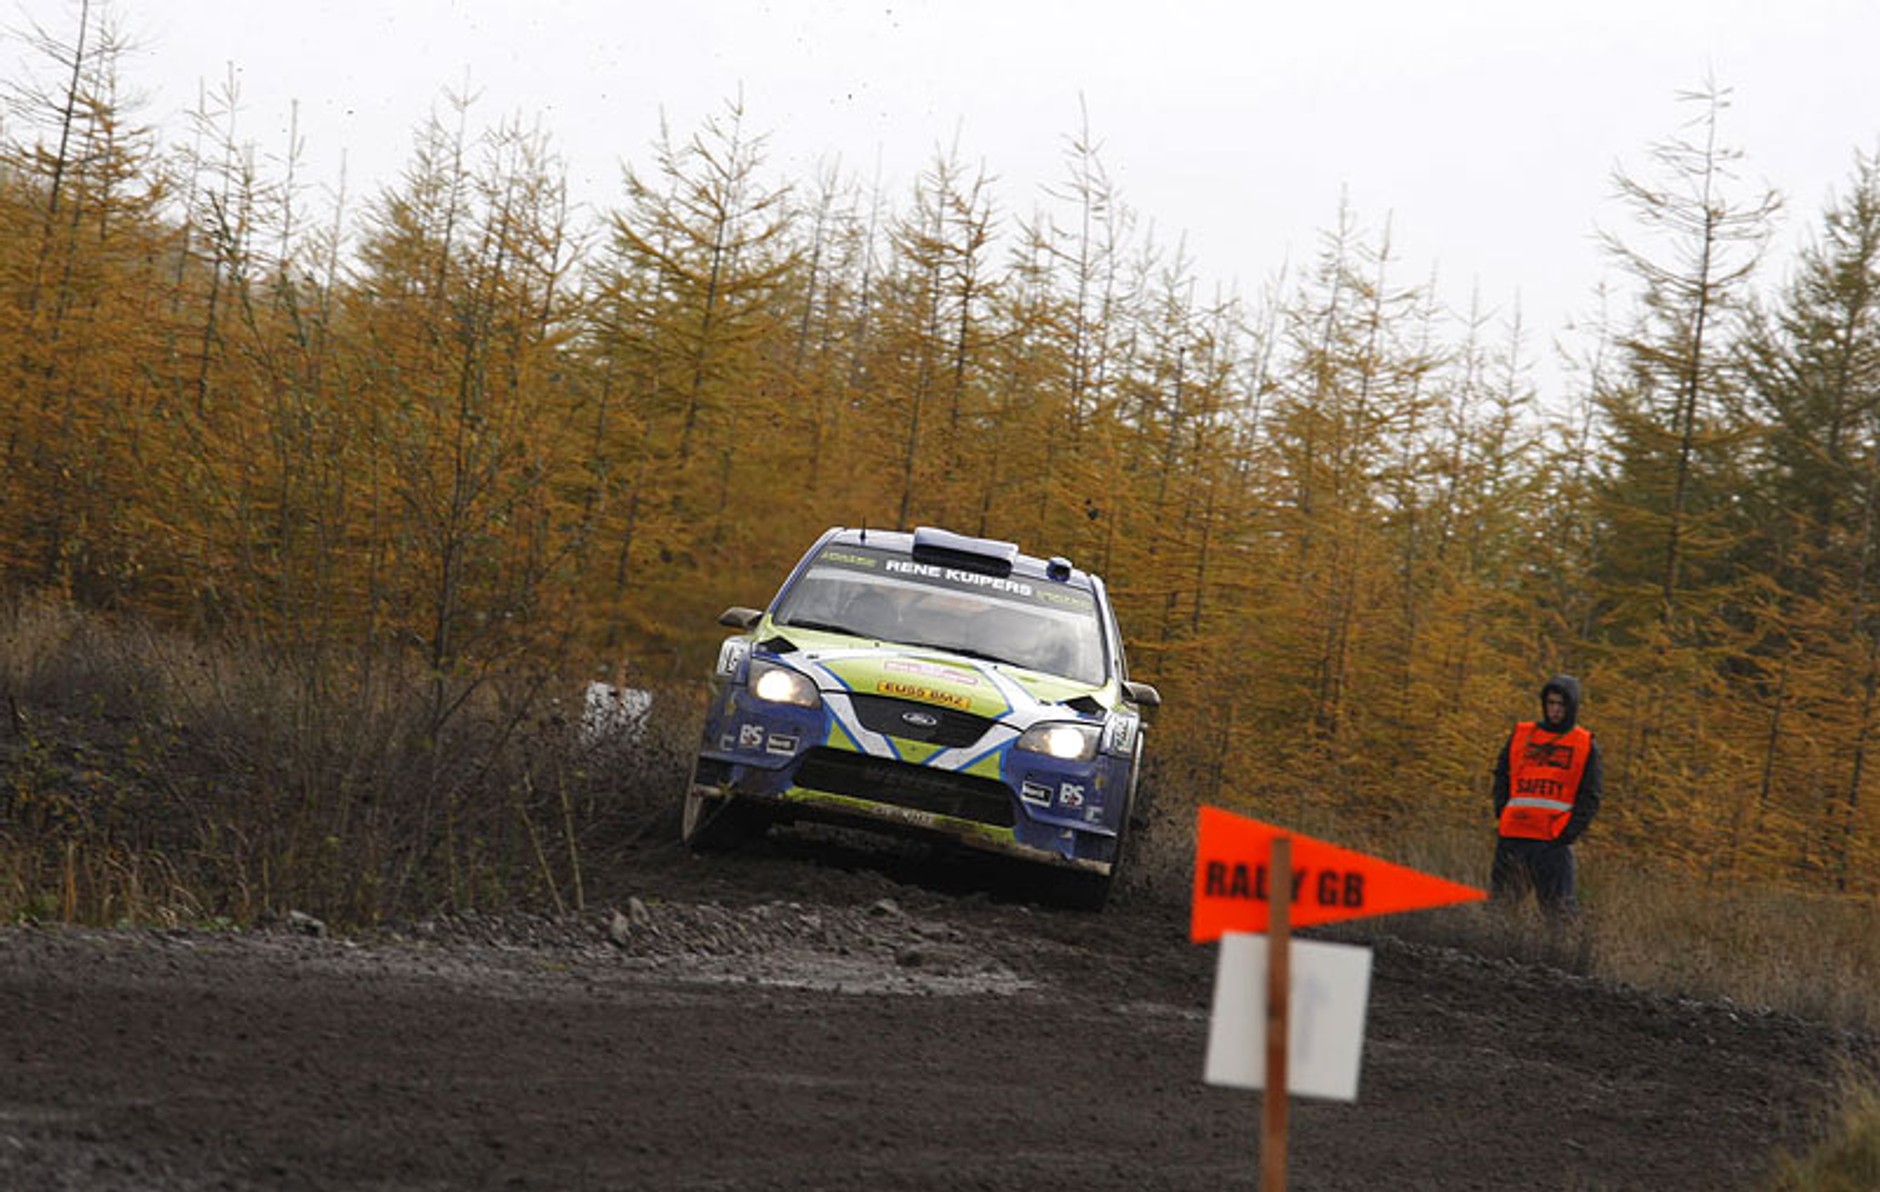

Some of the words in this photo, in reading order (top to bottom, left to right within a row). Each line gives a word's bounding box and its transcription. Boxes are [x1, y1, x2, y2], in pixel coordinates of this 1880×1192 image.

[885, 559, 941, 578] RENE
[945, 567, 1033, 597] KUIPERS
[1516, 778, 1563, 797] SAFETY
[1205, 859, 1307, 902] RALY
[1317, 869, 1365, 908] GB
